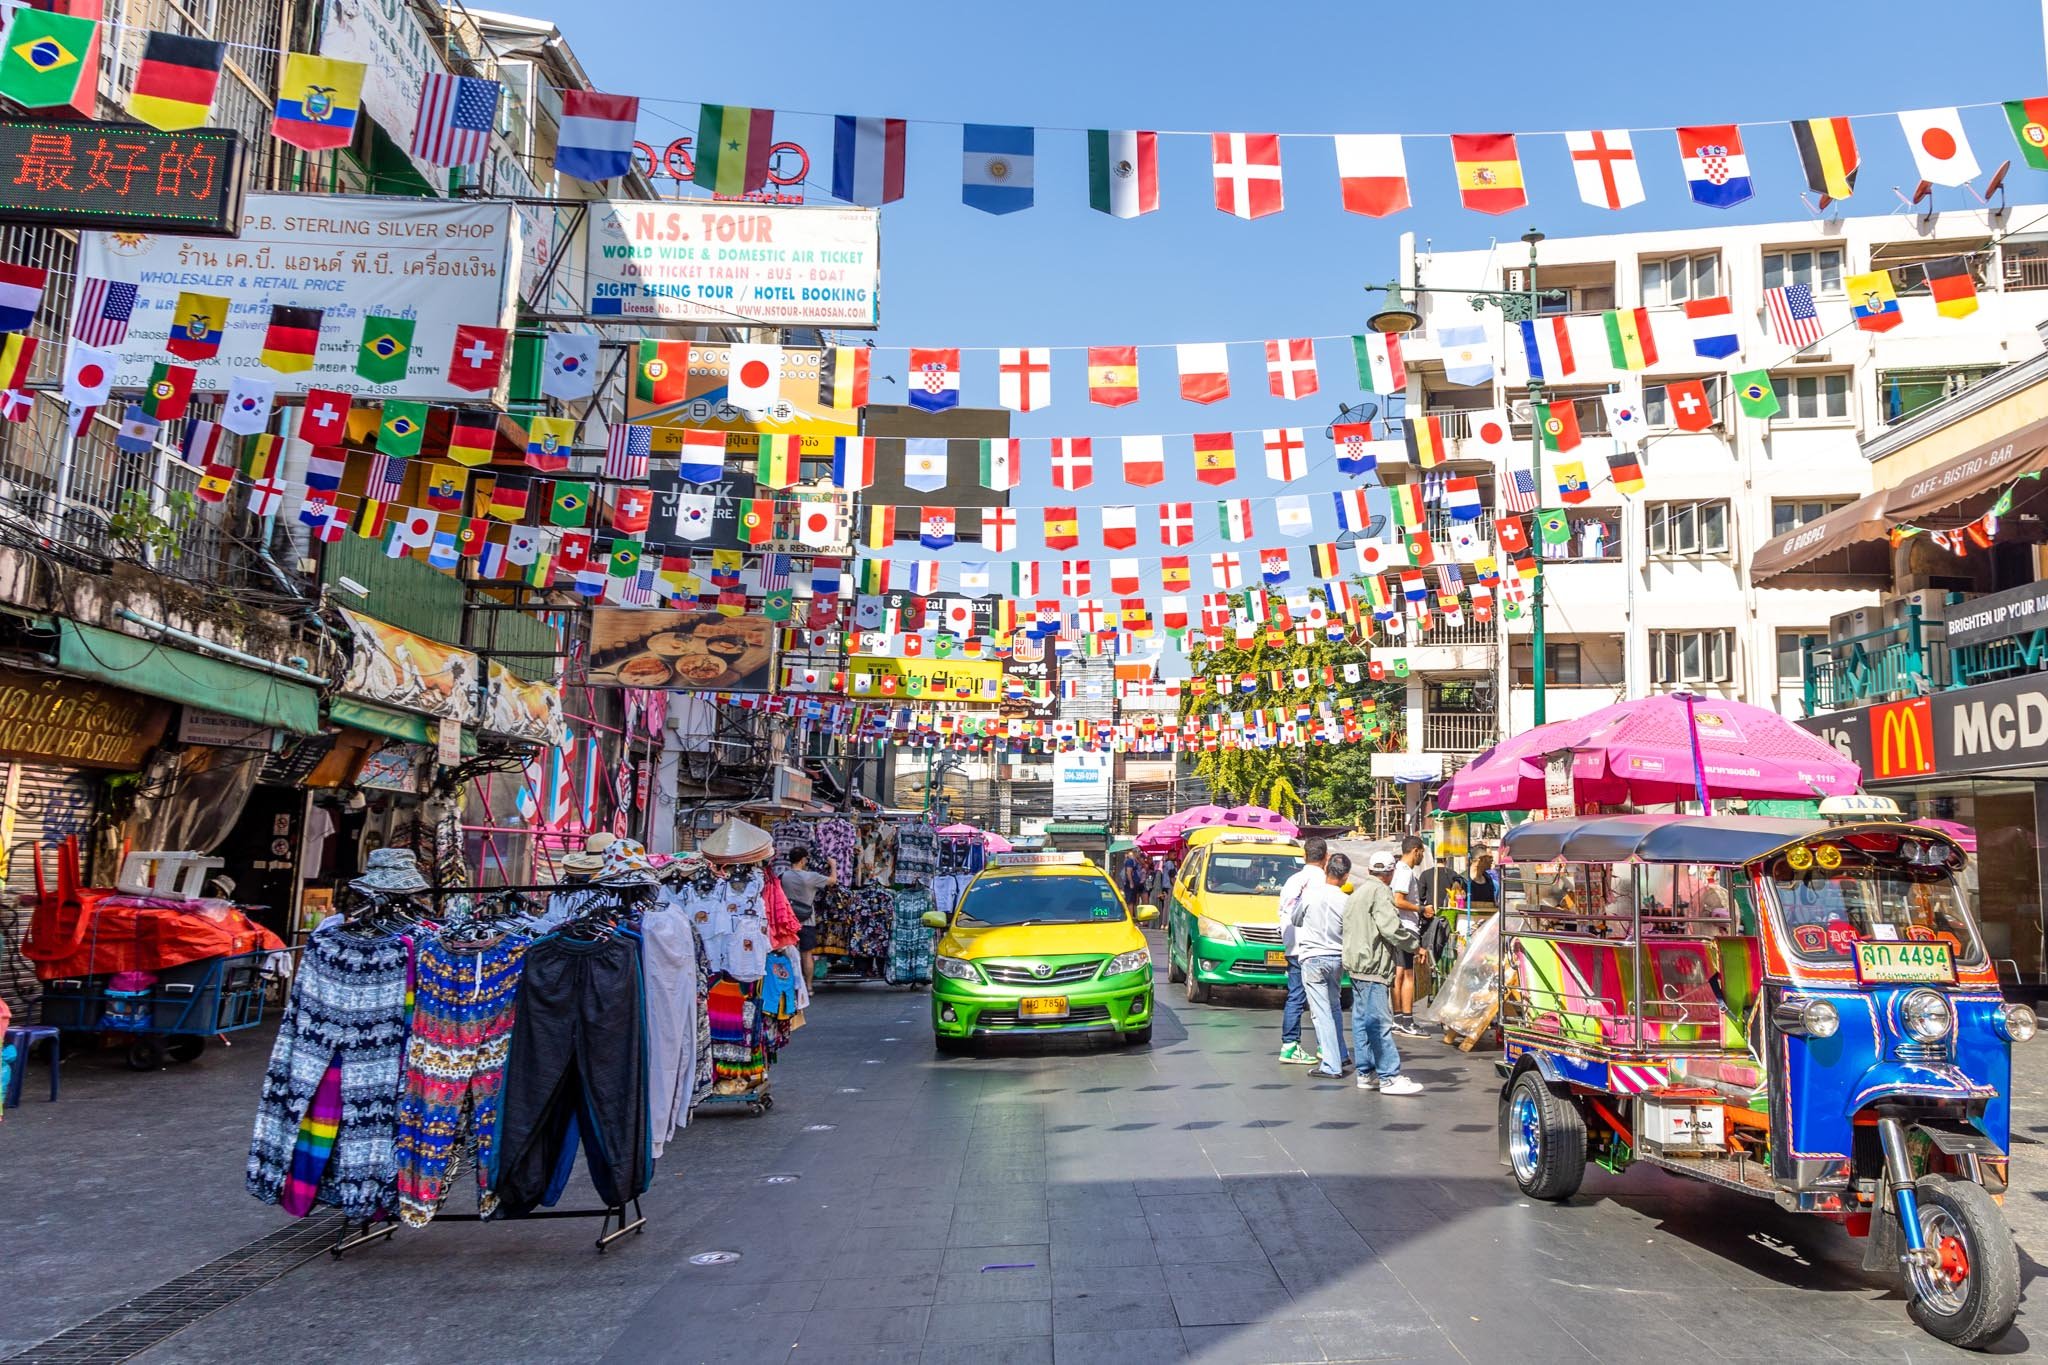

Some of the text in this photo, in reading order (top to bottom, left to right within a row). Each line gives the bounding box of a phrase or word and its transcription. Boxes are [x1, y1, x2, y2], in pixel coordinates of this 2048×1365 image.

[13, 134, 216, 200] 最好的
[243, 216, 494, 239] P.B. STERLING SILVER SHOP
[635, 211, 773, 244] N.S. TOUR
[178, 242, 496, 278] ร้าน เค.บี. แอนด์ พี.บี. เครื่องเงิน
[602, 245, 864, 265] WORLD WIDE & DOMESTIC AIR TICKET
[140, 271, 347, 292] WHOLESALER & RETAIL PRICE
[621, 263, 653, 278] JOIN
[659, 264, 702, 279] TICKET
[709, 265, 750, 280] TRAIN
[767, 267, 793, 281] BUS
[810, 268, 846, 282] BOAT
[596, 282, 637, 298] SIGHT
[643, 284, 691, 298] SEEING
[698, 285, 734, 299] TOUR
[754, 285, 796, 300] HOTEL
[802, 287, 867, 302] BOOKING
[623, 301, 655, 314] License
[658, 303, 674, 315] No.
[1911, 444, 2013, 499] CAFE BISTRO BAR
[754, 544, 849, 555] BAR & RESTAURANT
[1948, 611, 1993, 636] BRIGHTEN
[1993, 606, 2007, 623] UP
[2007, 599, 2036, 619] YOUR
[1029, 662, 1049, 675] 24
[28, 724, 91, 758] SILVER
[87, 733, 133, 763] SHOP
[1816, 774, 1836, 783] 1115
[1841, 797, 1892, 809] TAXI
[1899, 946, 1947, 966] 4494
[1043, 998, 1065, 1008] 7850
[1684, 1121, 1713, 1129] YASA
